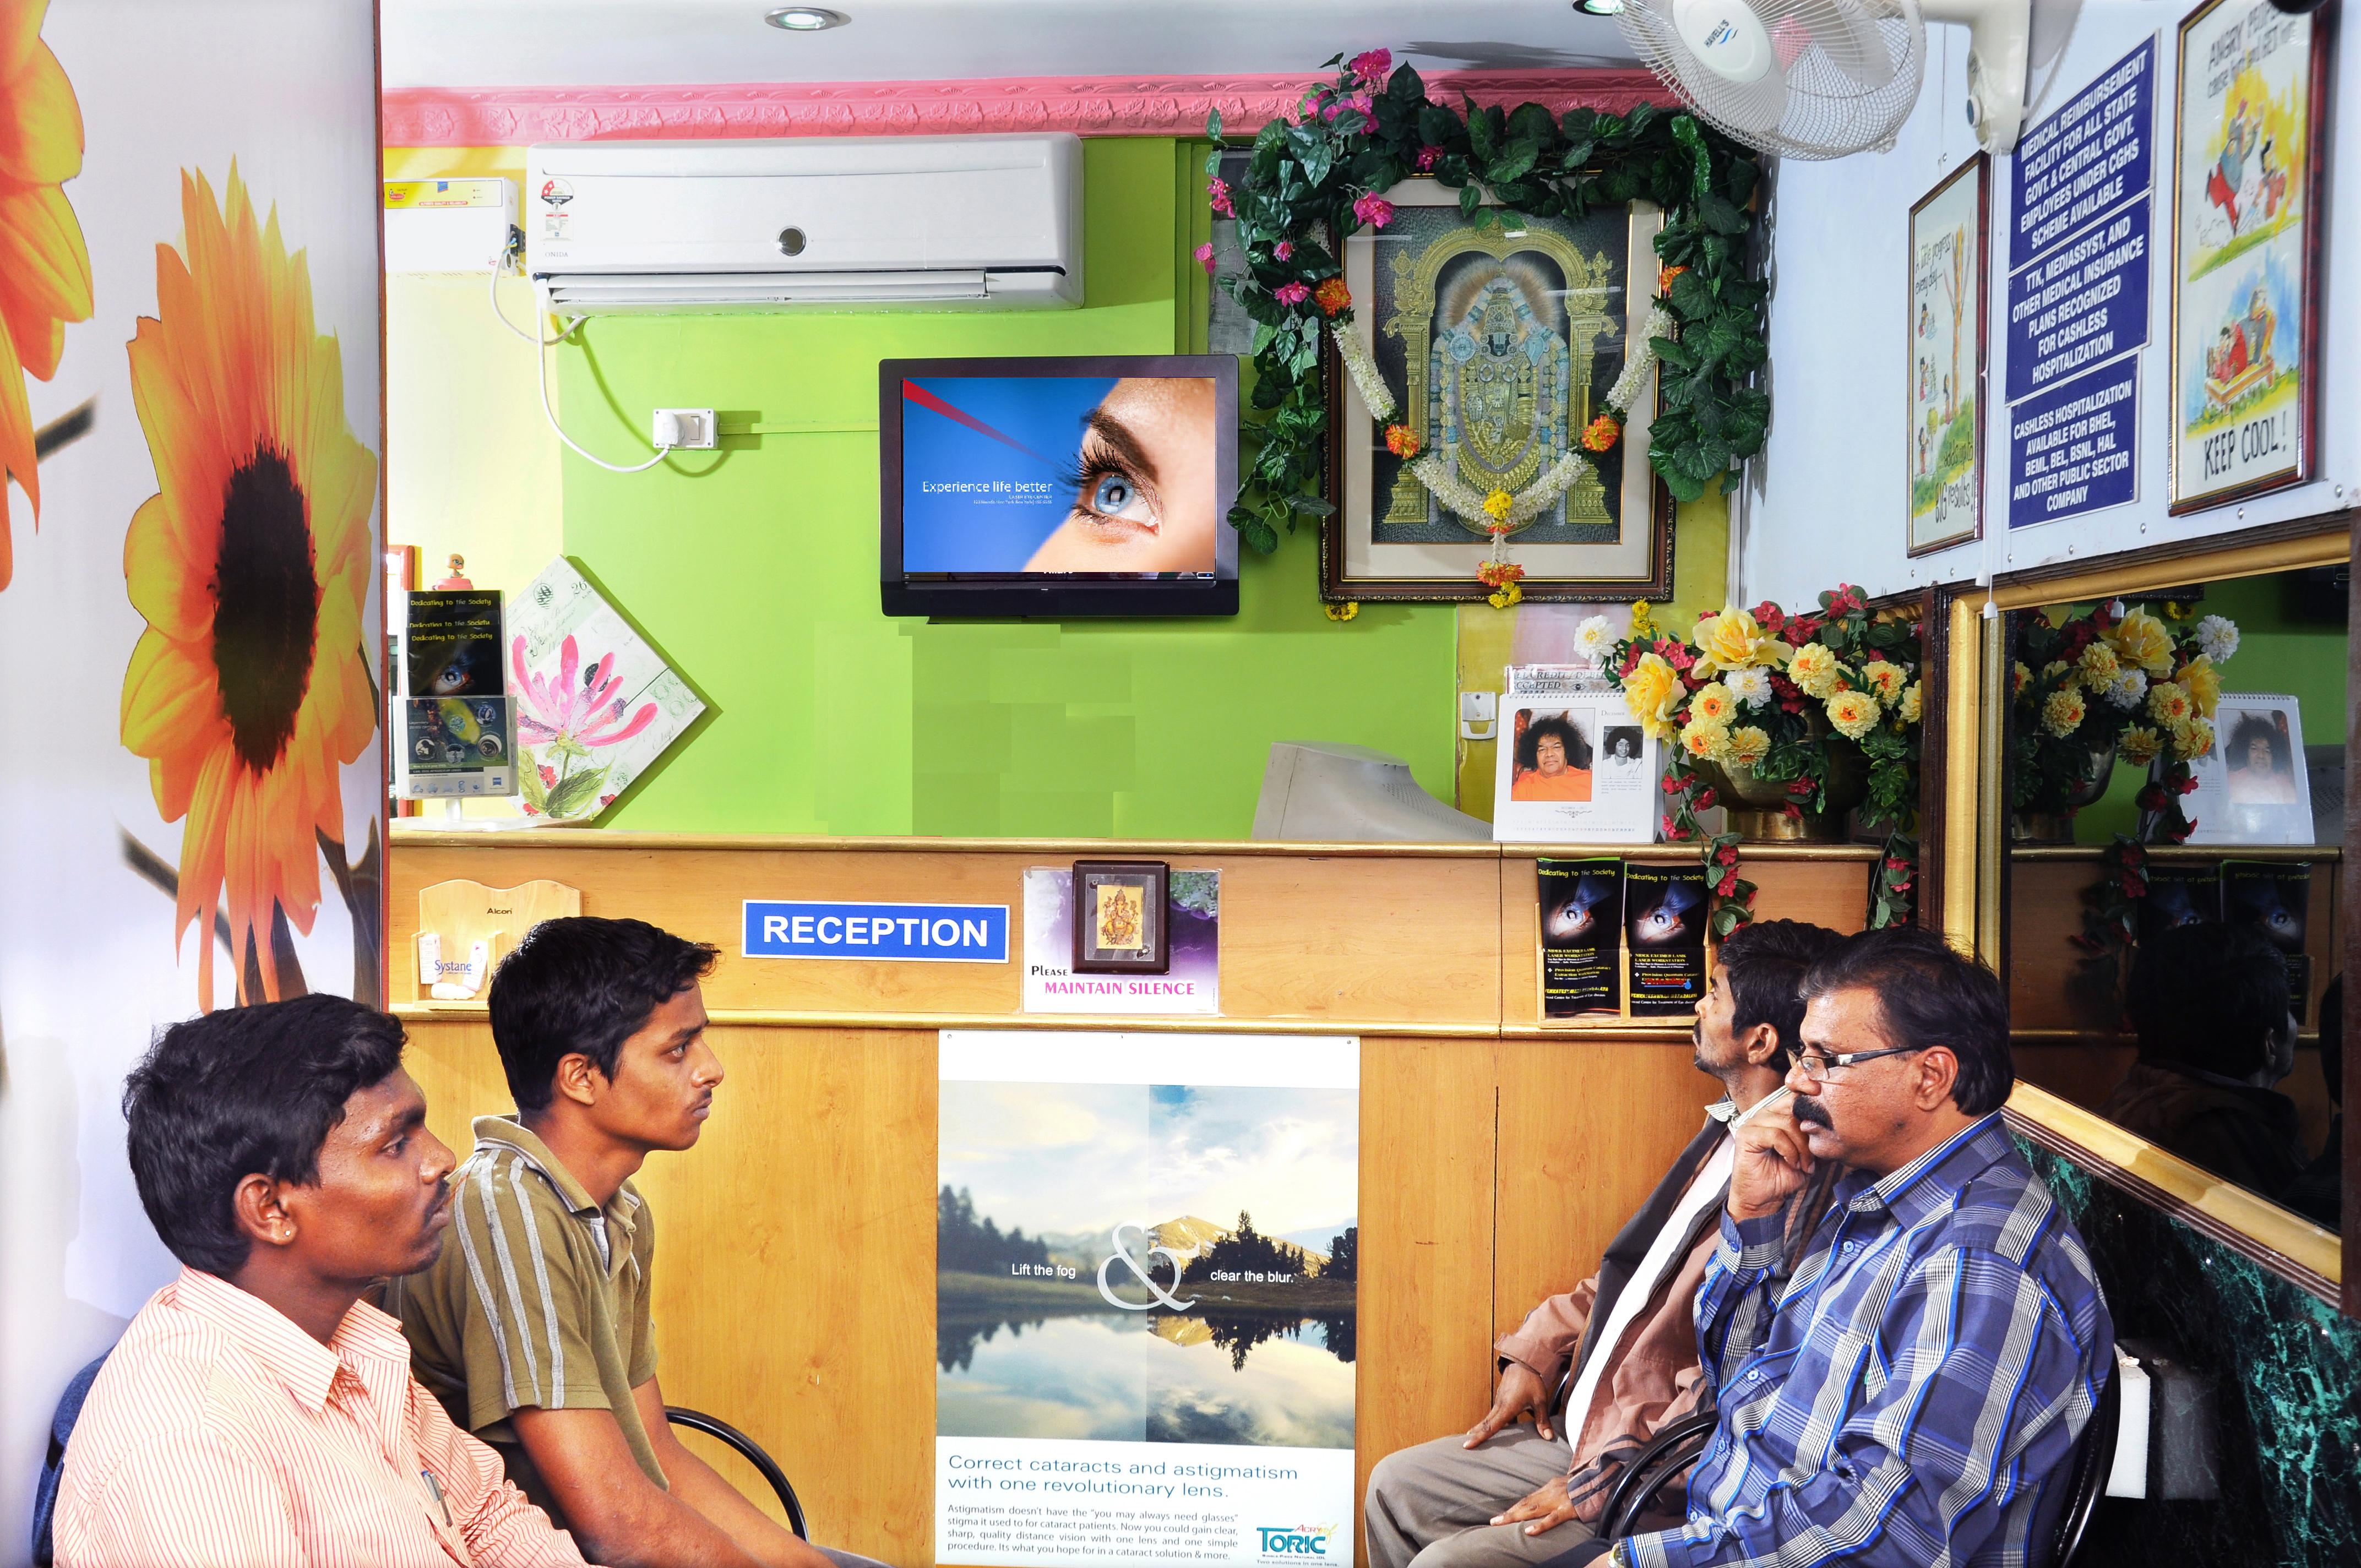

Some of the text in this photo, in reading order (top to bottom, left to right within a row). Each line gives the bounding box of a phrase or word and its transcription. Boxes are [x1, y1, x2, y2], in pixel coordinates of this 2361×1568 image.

[2021, 49, 2147, 163] MEDICAL REIMBURSEMENT
[2025, 84, 2137, 183] FACILITY FOR ALL STATE
[2050, 168, 2058, 189] &
[2059, 138, 2103, 182] CENTRAL
[2021, 138, 2140, 233] EMPLOYEES UNDER CGHS
[2032, 175, 2124, 249] SCHEME AVAILABLE
[2107, 215, 2131, 246] AND
[2013, 234, 2144, 323] OTHER MEDICAL INSURANCE
[2028, 275, 2121, 339] PLANS RECOGNIZED
[2038, 307, 2108, 358] FOR CASHLESS
[2032, 330, 2114, 385] HOSPITALIZATION
[2014, 379, 2132, 440] CASHLESS HOSPITALIZATION
[2026, 411, 2116, 456] AVAILABLE FOR BHEL,
[2025, 432, 2117, 477] BEML, BEL, BSNL, HAL
[2205, 429, 2235, 481] KEEP
[922, 481, 1053, 494] Experience life better
[2014, 450, 2129, 501] AND OTHER PUBLIC SECTOR
[1935, 482, 1947, 523] BIG
[2047, 485, 2088, 512] COMPANY
[1538, 869, 1569, 878] Dedicating
[1626, 873, 1658, 882] Dedicating
[764, 916, 987, 947] RECEPTION
[434, 960, 472, 974] Systane
[1045, 982, 1195, 995] MAINTAIN SILENCE
[1012, 1263, 1076, 1280] Lift the fog
[1097, 1220, 1200, 1311] &
[1211, 1270, 1294, 1283] clear the blur.
[949, 1455, 1297, 1480] Correct cataracts and astigmatism
[948, 1475, 1228, 1499] with one revolutionary lens.
[948, 1504, 1238, 1523] Astigmatism doesn't have the "you may always need glasses"
[948, 1517, 1238, 1537] stigma it used to for cataract patients. Now you could gain clear,
[948, 1528, 975, 1540] sharp,
[980, 1530, 1011, 1542] quality
[1016, 1531, 1054, 1541] distance
[1059, 1533, 1086, 1542] vision
[1091, 1533, 1111, 1543] with
[1139, 1535, 1157, 1545] lens
[1162, 1537, 1179, 1545] and
[1207, 1538, 1238, 1549] simple
[948, 1542, 997, 1552] procedure.
[999, 1542, 1010, 1552] Its
[1011, 1543, 1035, 1553] what
[1037, 1546, 1054, 1555] you
[1056, 1544, 1080, 1556] hope
[1082, 1545, 1095, 1555] for
[1097, 1547, 1106, 1555] in
[1116, 1548, 1152, 1557] cataract
[1155, 1548, 1192, 1559] solution
[1194, 1550, 1201, 1559] &
[1204, 1552, 1231, 1561] more.
[1256, 1527, 1326, 1554] TORIC
